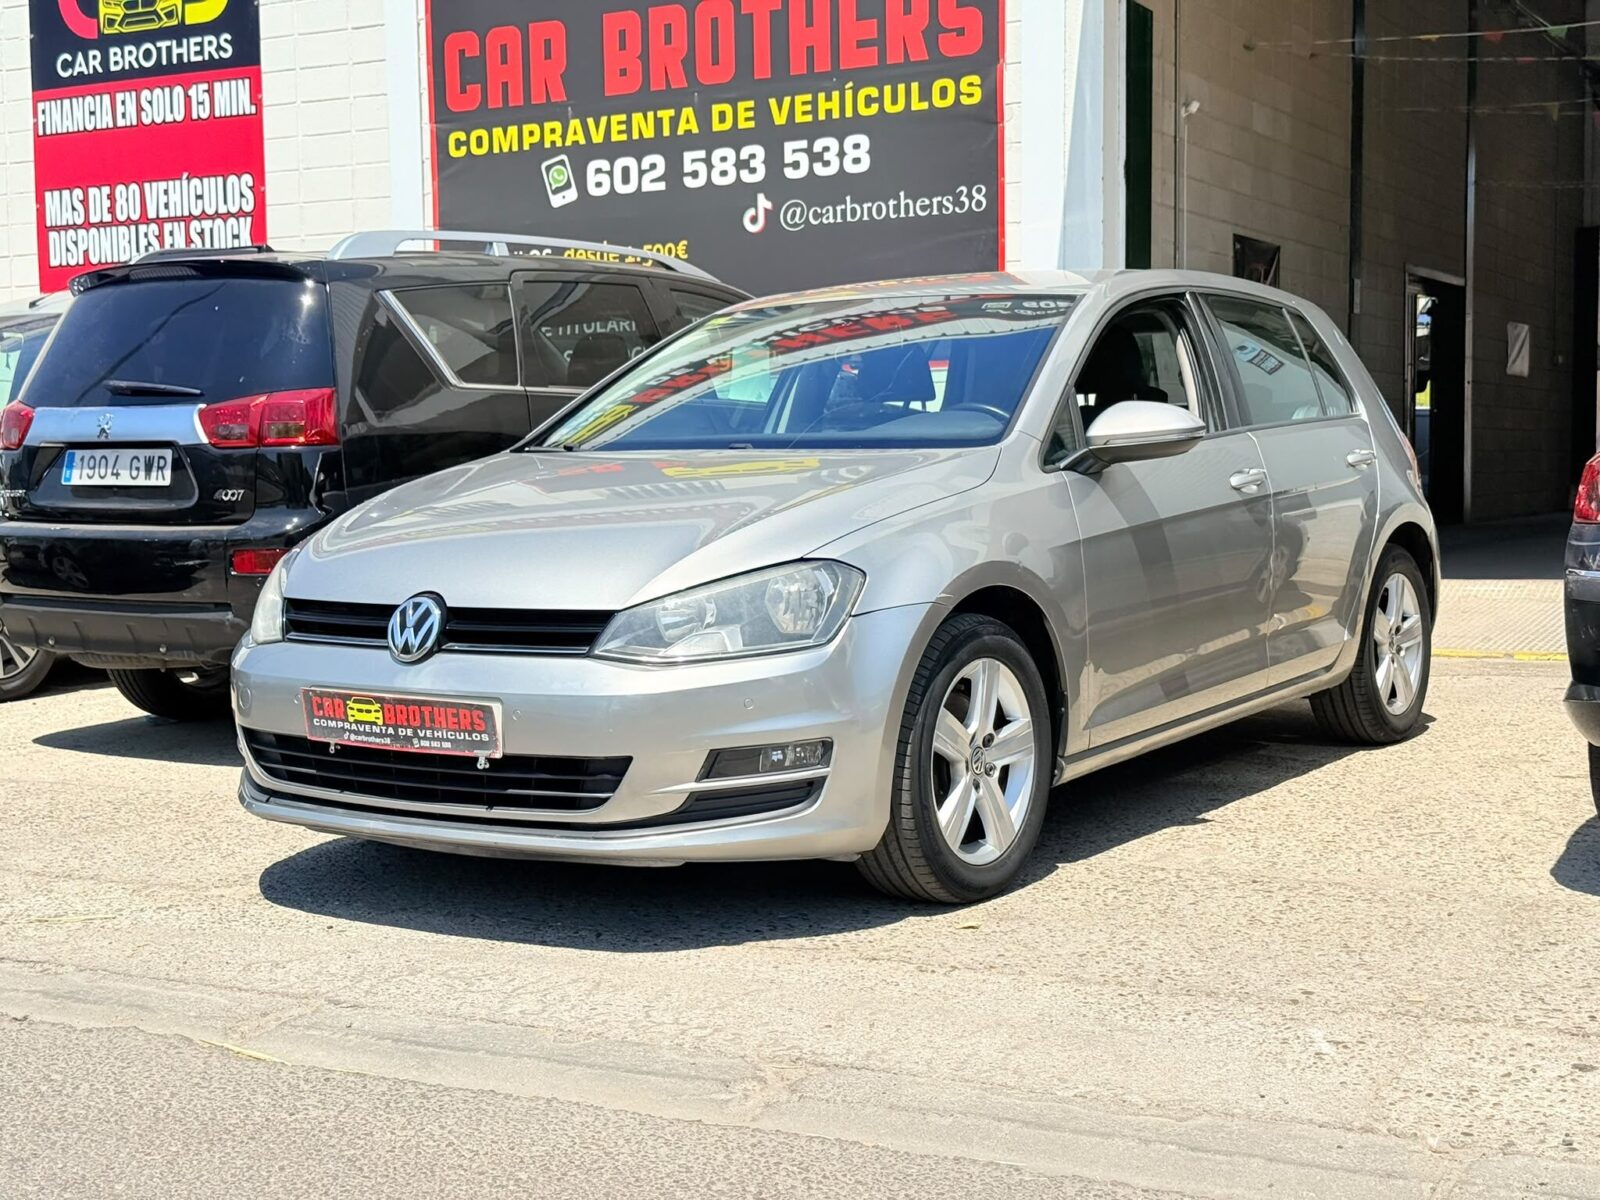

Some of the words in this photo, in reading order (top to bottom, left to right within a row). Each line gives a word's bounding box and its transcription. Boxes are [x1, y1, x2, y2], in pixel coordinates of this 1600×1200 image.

[56, 48, 103, 79] CAR
[109, 32, 234, 72] BROTHERS
[443, 20, 568, 113] CAR
[602, 0, 984, 97] BROTHERS
[37, 91, 114, 137] FINANCIA
[115, 90, 138, 128] EN
[140, 83, 186, 126] SOLO
[187, 83, 211, 121] 15
[213, 77, 256, 118] MIN.
[447, 112, 699, 159] COMPRAVENTA
[711, 101, 756, 133] DE
[767, 73, 983, 127] VEHÍCULOS
[585, 152, 667, 198] 602
[682, 143, 767, 191] 583
[782, 132, 872, 182] 538
[44, 186, 85, 228] MAS
[87, 184, 112, 225] DE
[114, 182, 141, 222] 80
[143, 171, 255, 221] VEHÍCULOS
[779, 184, 988, 232] @carbrothers38
[47, 222, 161, 268] DISPONIBLES
[163, 219, 187, 251] EN
[189, 215, 254, 251] STOCK
[79, 454, 121, 481] 1904
[129, 454, 166, 481] GWR
[312, 696, 346, 719] CAR
[383, 704, 486, 732] BROTHERS
[313, 718, 395, 735] COMPRAVENTA
[398, 727, 414, 737] DE
[417, 729, 490, 742] VEHÍCULOS
